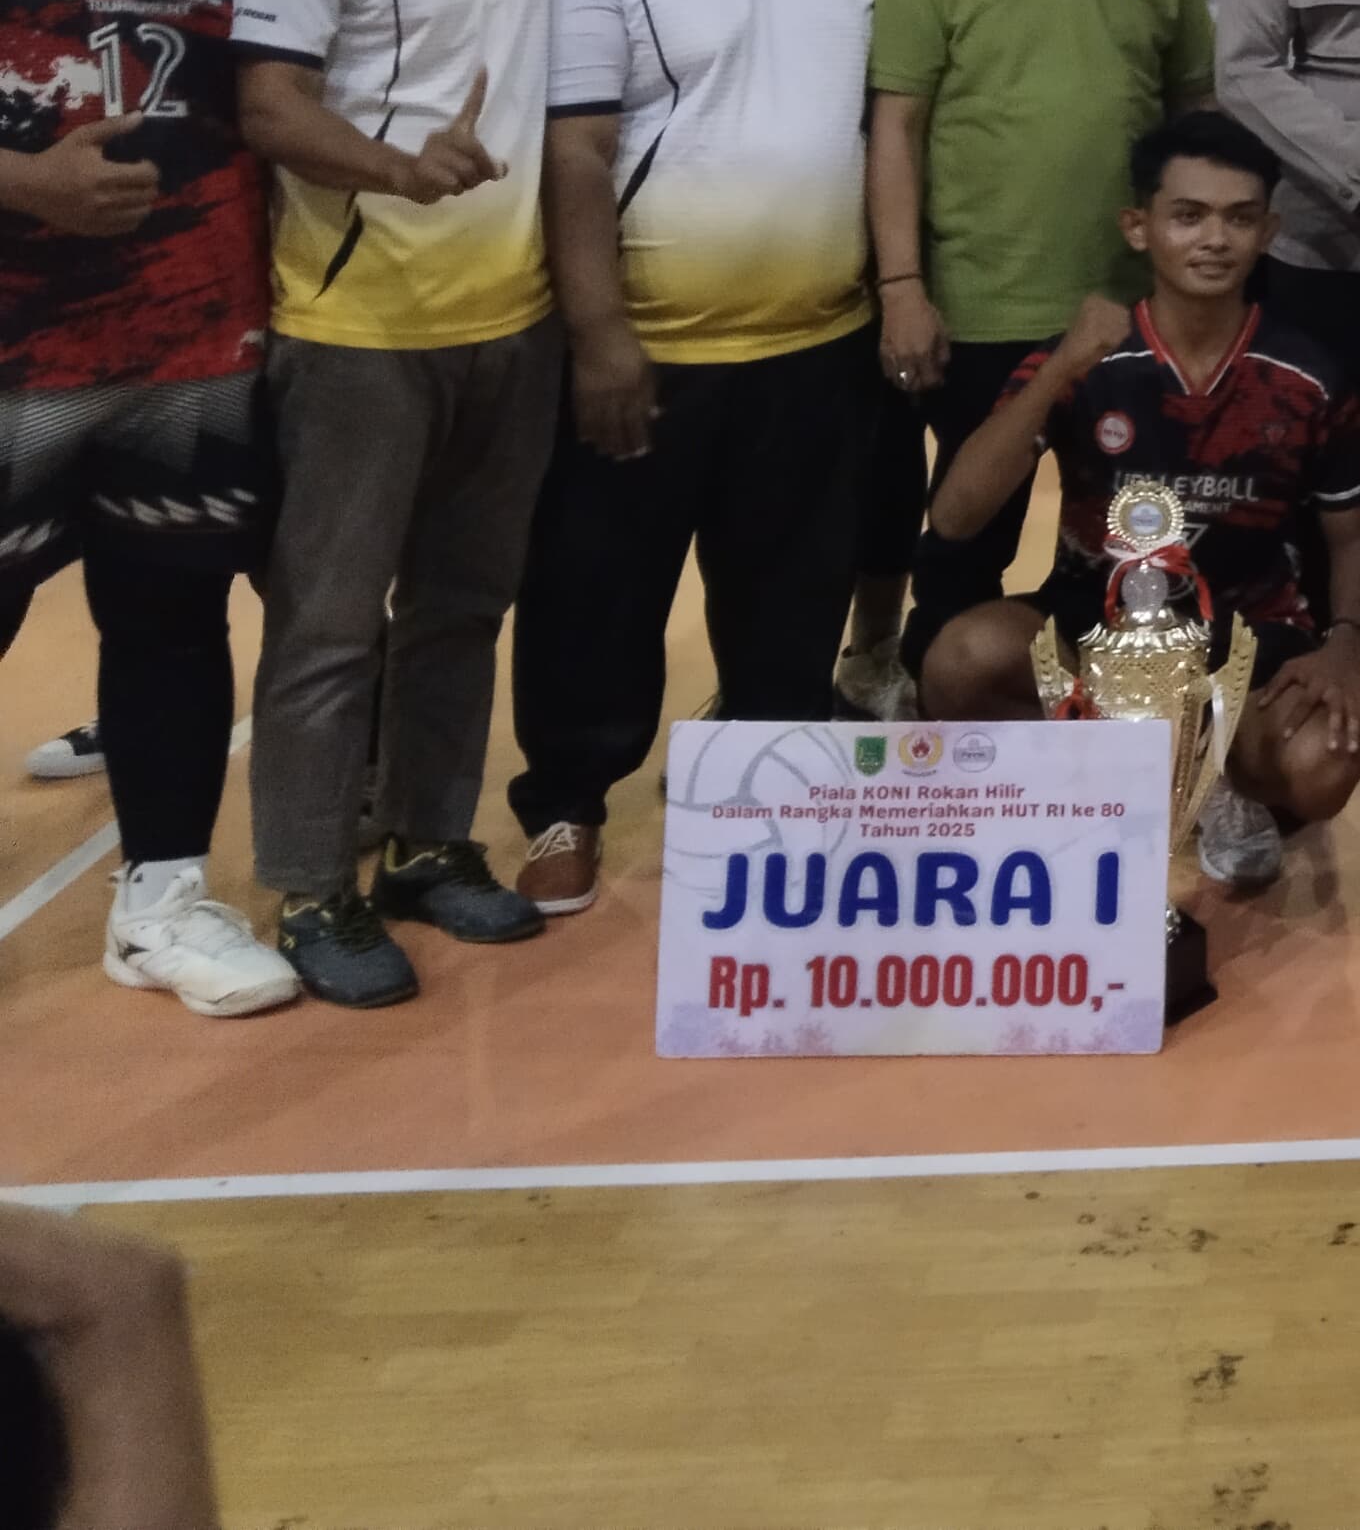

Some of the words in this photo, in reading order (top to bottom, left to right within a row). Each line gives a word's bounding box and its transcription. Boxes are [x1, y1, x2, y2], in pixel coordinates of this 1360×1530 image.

[88, 22, 190, 117] 12
[712, 804, 773, 819] Dalam
[780, 804, 852, 823] Rangka
[859, 803, 994, 819] Memeriahkan
[1001, 804, 1039, 818] HUT
[1047, 804, 1066, 818] RI
[1071, 803, 1095, 818] ke
[1101, 803, 1125, 818] 80
[809, 785, 857, 800] Piala
[863, 785, 910, 800] KONI
[918, 785, 979, 800] Rokan
[985, 784, 1025, 799] Hilir
[860, 823, 920, 838] Tahun
[927, 823, 976, 837] 2025
[702, 850, 1053, 930] JUARA
[1096, 851, 1120, 926] I
[708, 956, 785, 1017] Rp.
[806, 953, 1124, 1012] 10.000.000,-
